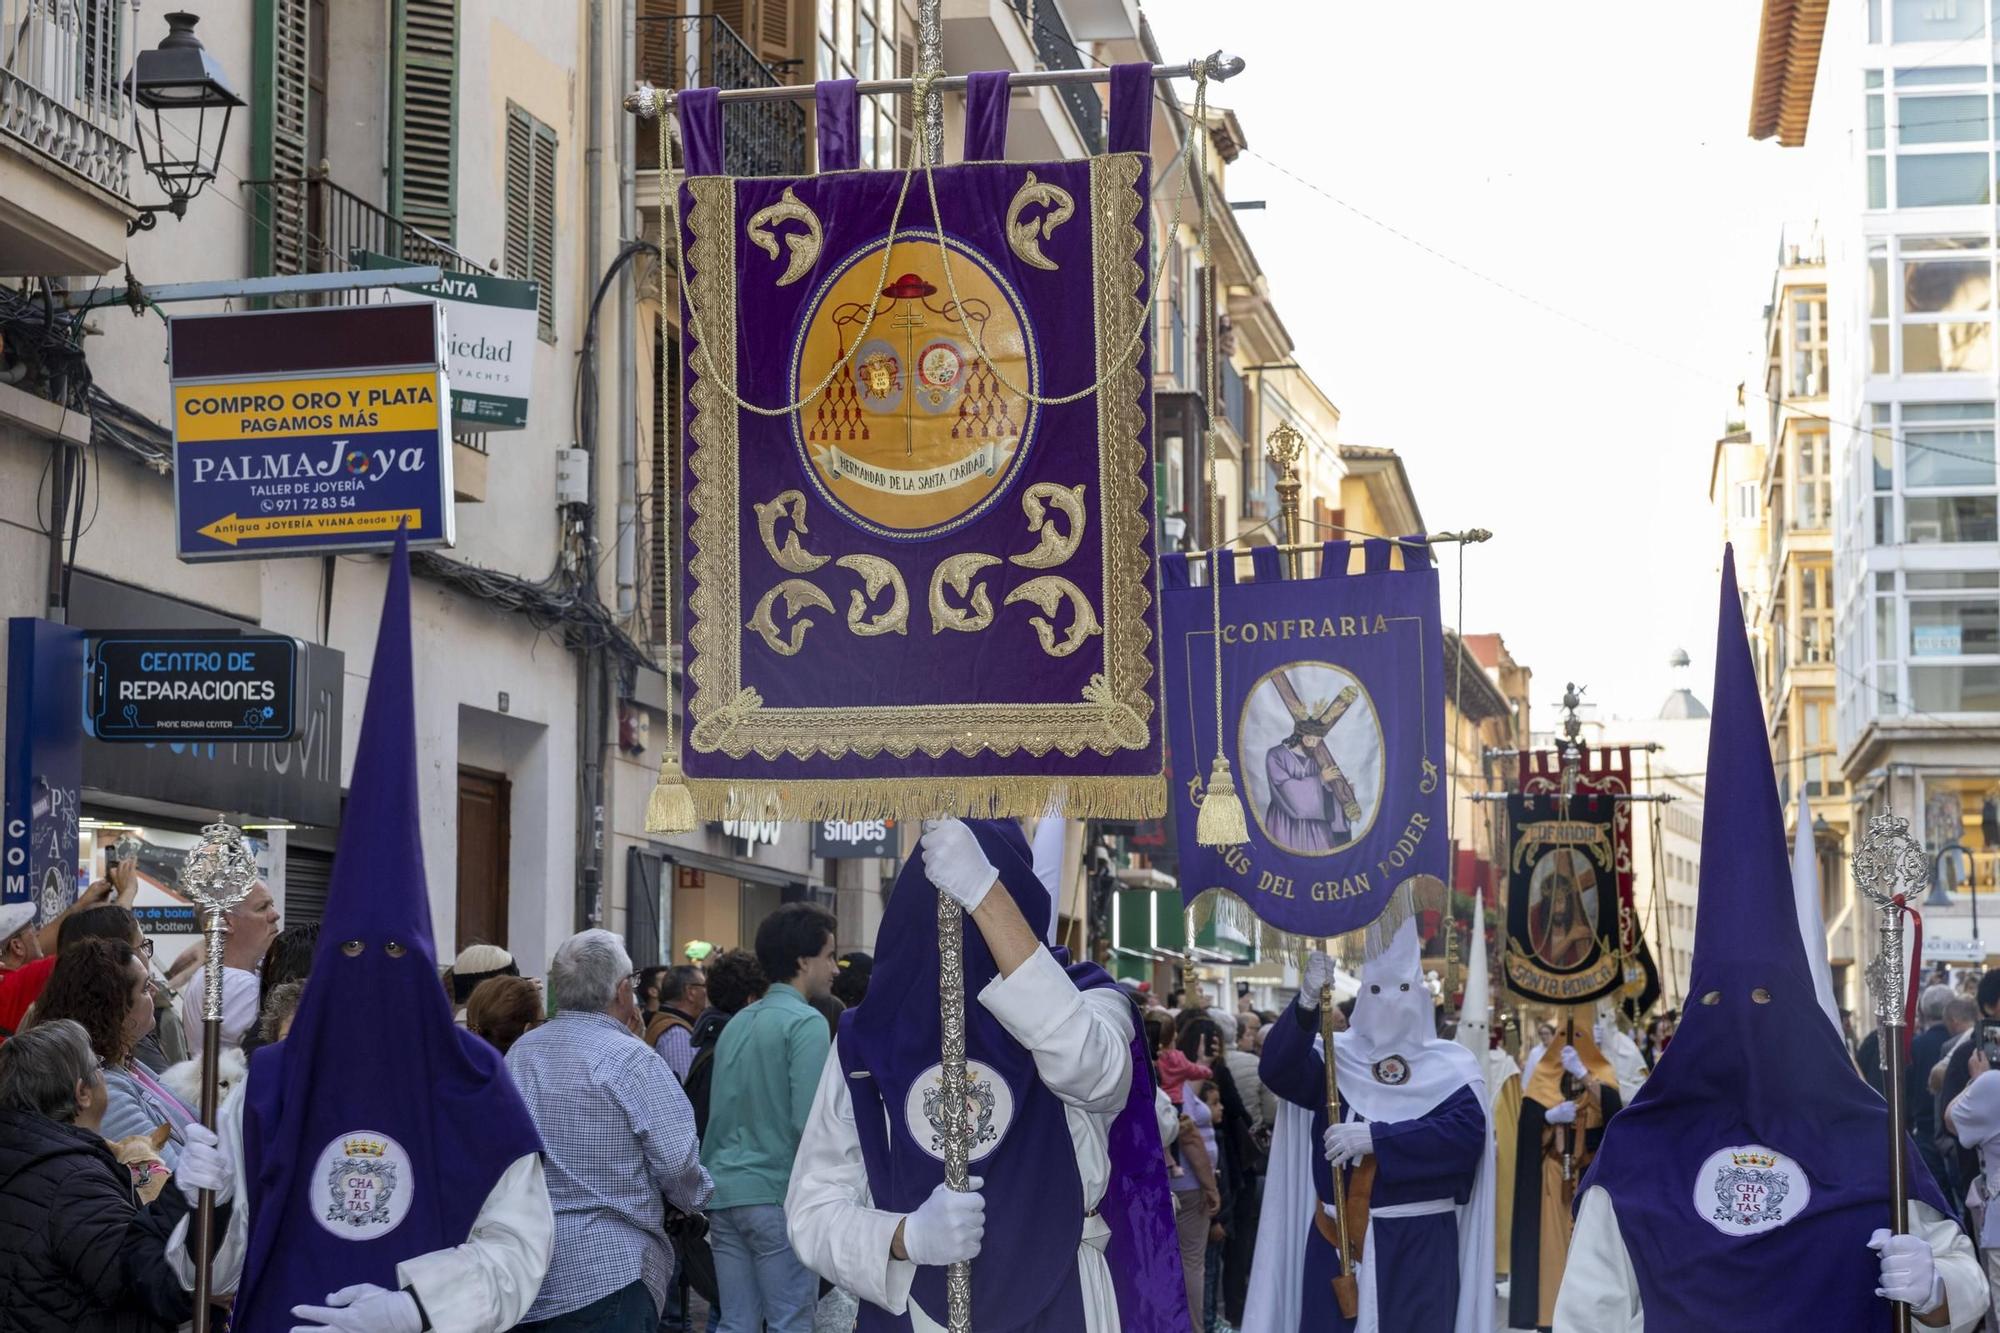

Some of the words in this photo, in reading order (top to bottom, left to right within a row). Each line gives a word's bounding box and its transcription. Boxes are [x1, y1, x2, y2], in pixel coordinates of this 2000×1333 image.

[422, 278, 478, 299] ENTA
[448, 333, 513, 363] iedad
[457, 369, 511, 383] YACHTS
[184, 395, 285, 416] COMPRO
[292, 391, 341, 409] ORO
[348, 390, 361, 407] Y
[368, 387, 433, 406] PLATA
[241, 415, 333, 433] PAGAMOS
[339, 408, 379, 427] MÁS
[840, 456, 886, 486] HERMANDAD
[889, 475, 901, 490] DE
[903, 477, 915, 490] LA
[918, 472, 946, 490] SANTA
[949, 453, 986, 481] CARIDAD
[251, 484, 291, 496] TALLER
[294, 482, 309, 494] DE
[312, 477, 365, 493] JOYERÍA
[276, 498, 298, 511] 971
[303, 498, 318, 510] 72
[321, 497, 336, 508] 83
[340, 496, 356, 508] 54
[214, 523, 260, 535] Antigua
[265, 516, 314, 530] JOYERÍA
[318, 516, 355, 528] VIANA
[357, 515, 386, 525] desde
[390, 514, 413, 523] 180
[1222, 614, 1389, 644] CONFRARIA
[140, 652, 222, 672] CENTRO
[228, 652, 256, 671] DE
[119, 681, 275, 700] REPARACIONES
[157, 720, 179, 729] PHONE
[181, 720, 205, 729] REPAIR
[206, 720, 233, 729] CENTER
[1257, 870, 1295, 900] DEL
[1311, 872, 1372, 902] GRAN
[1377, 811, 1431, 879] PODER
[147, 908, 161, 918] de
[156, 921, 193, 932] battery
[1514, 964, 1558, 995] SANTA
[348, 1177, 374, 1189] CHA
[1736, 1183, 1764, 1194] CHA
[354, 1189, 367, 1200] RI
[1743, 1193, 1757, 1203] RI
[348, 1200, 371, 1212] TAS
[1736, 1203, 1761, 1212] TAS
